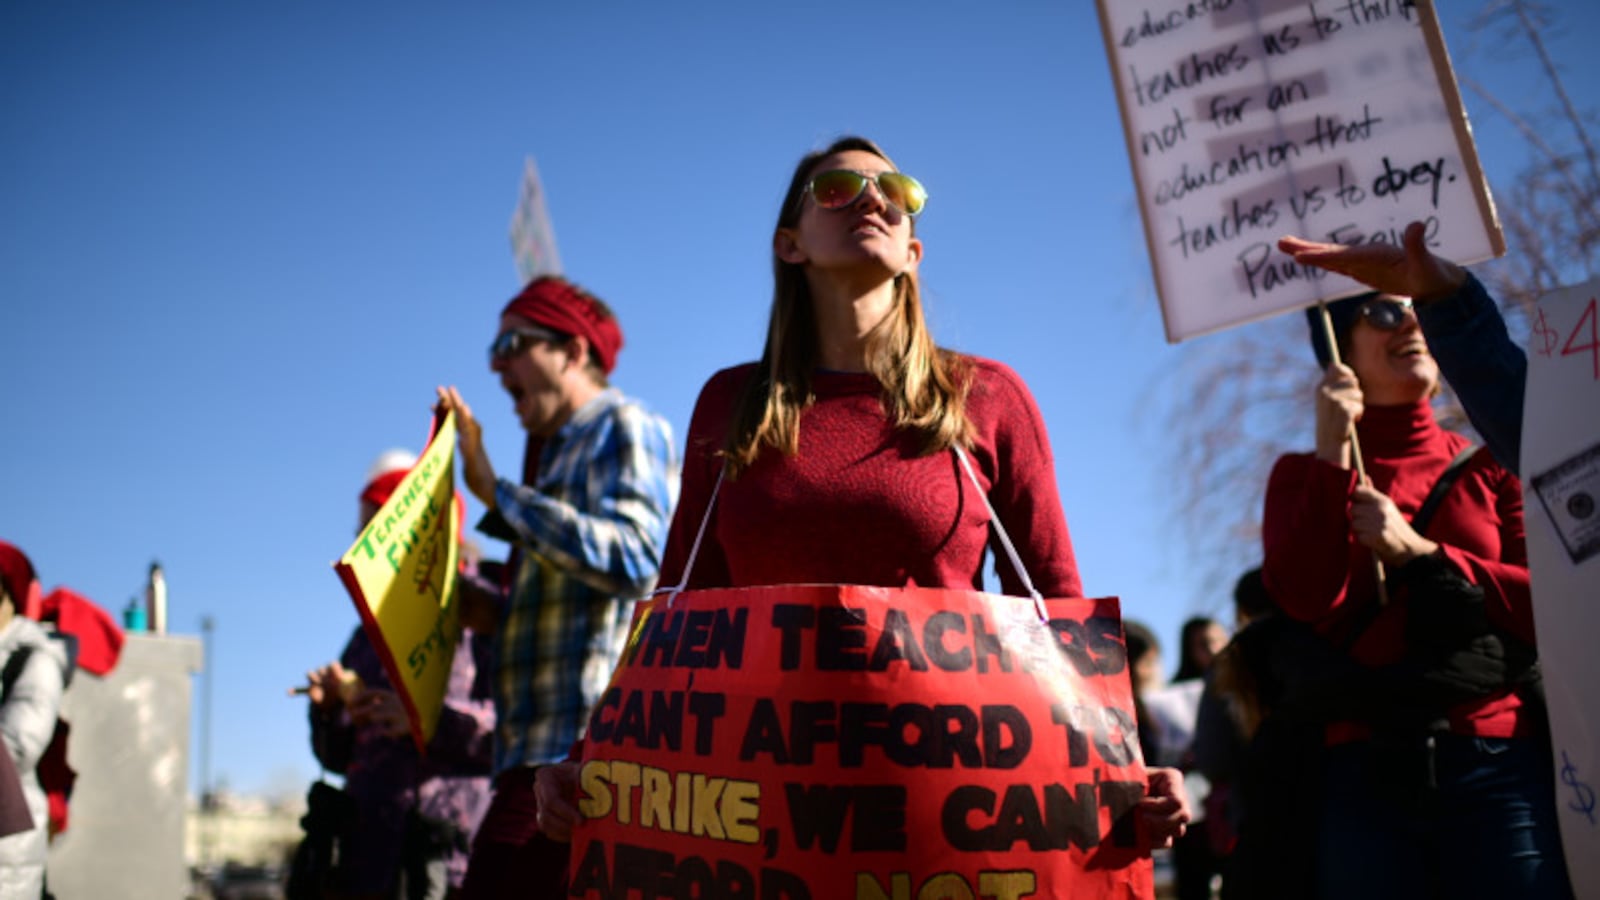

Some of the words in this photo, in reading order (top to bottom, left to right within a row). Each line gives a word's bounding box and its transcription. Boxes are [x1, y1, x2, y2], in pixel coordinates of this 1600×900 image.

[1129, 44, 1251, 106] teaches
[1263, 24, 1300, 55] us
[1306, 0, 1342, 40] to
[1141, 107, 1190, 156] not
[1208, 95, 1251, 129] for
[1267, 79, 1310, 112] an
[1154, 140, 1301, 205] education
[1304, 104, 1383, 152] that
[1169, 199, 1278, 258] teaches
[1288, 186, 1326, 220] us
[1335, 164, 1366, 209] to
[1373, 156, 1457, 210] obey.
[590, 671, 726, 757] CAN'T
[738, 698, 1033, 770] AFFORD
[1051, 702, 1138, 768] TO
[783, 782, 907, 855] WE
[941, 767, 1147, 855] CAN'T
